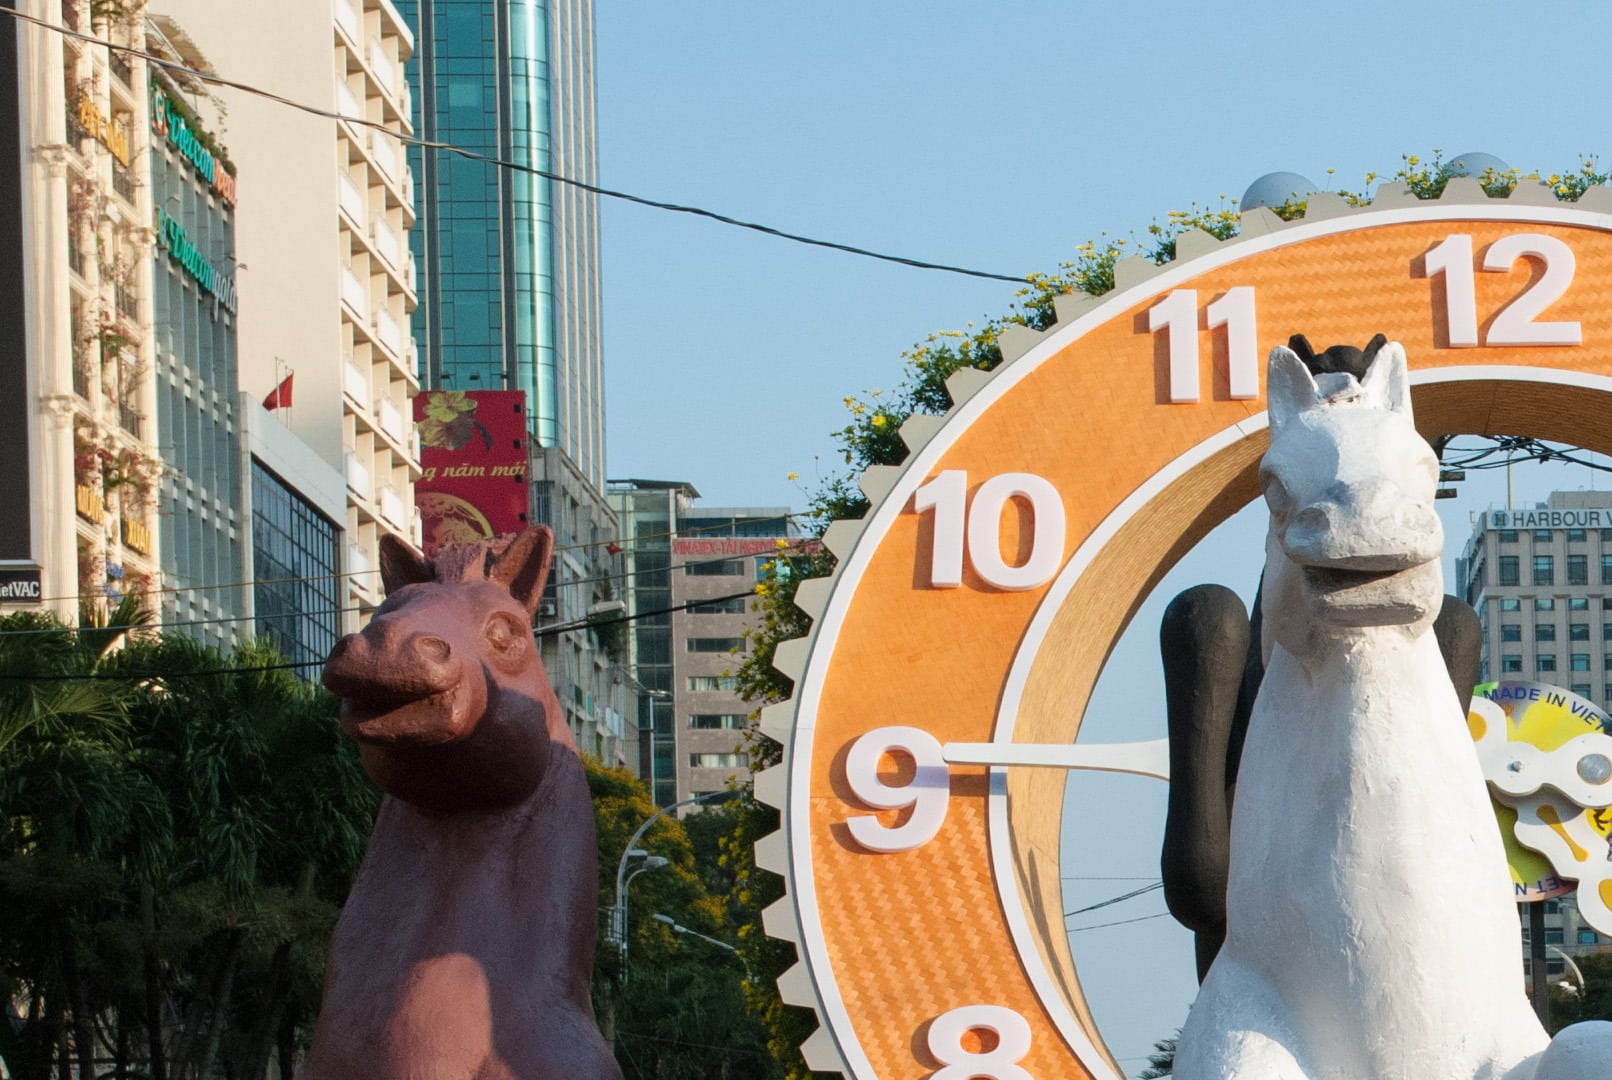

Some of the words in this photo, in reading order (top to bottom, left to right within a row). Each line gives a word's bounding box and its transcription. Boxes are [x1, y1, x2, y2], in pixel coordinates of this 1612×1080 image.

[1425, 233, 1582, 346] 12
[1149, 286, 1259, 401] 11
[441, 462, 485, 477] năm
[914, 470, 1066, 589] 10
[1513, 511, 1600, 527] HARBOUR
[0, 581, 40, 598] etVAC
[1483, 686, 1541, 701] MADE
[1546, 691, 1566, 708] IN
[846, 726, 952, 852] 9
